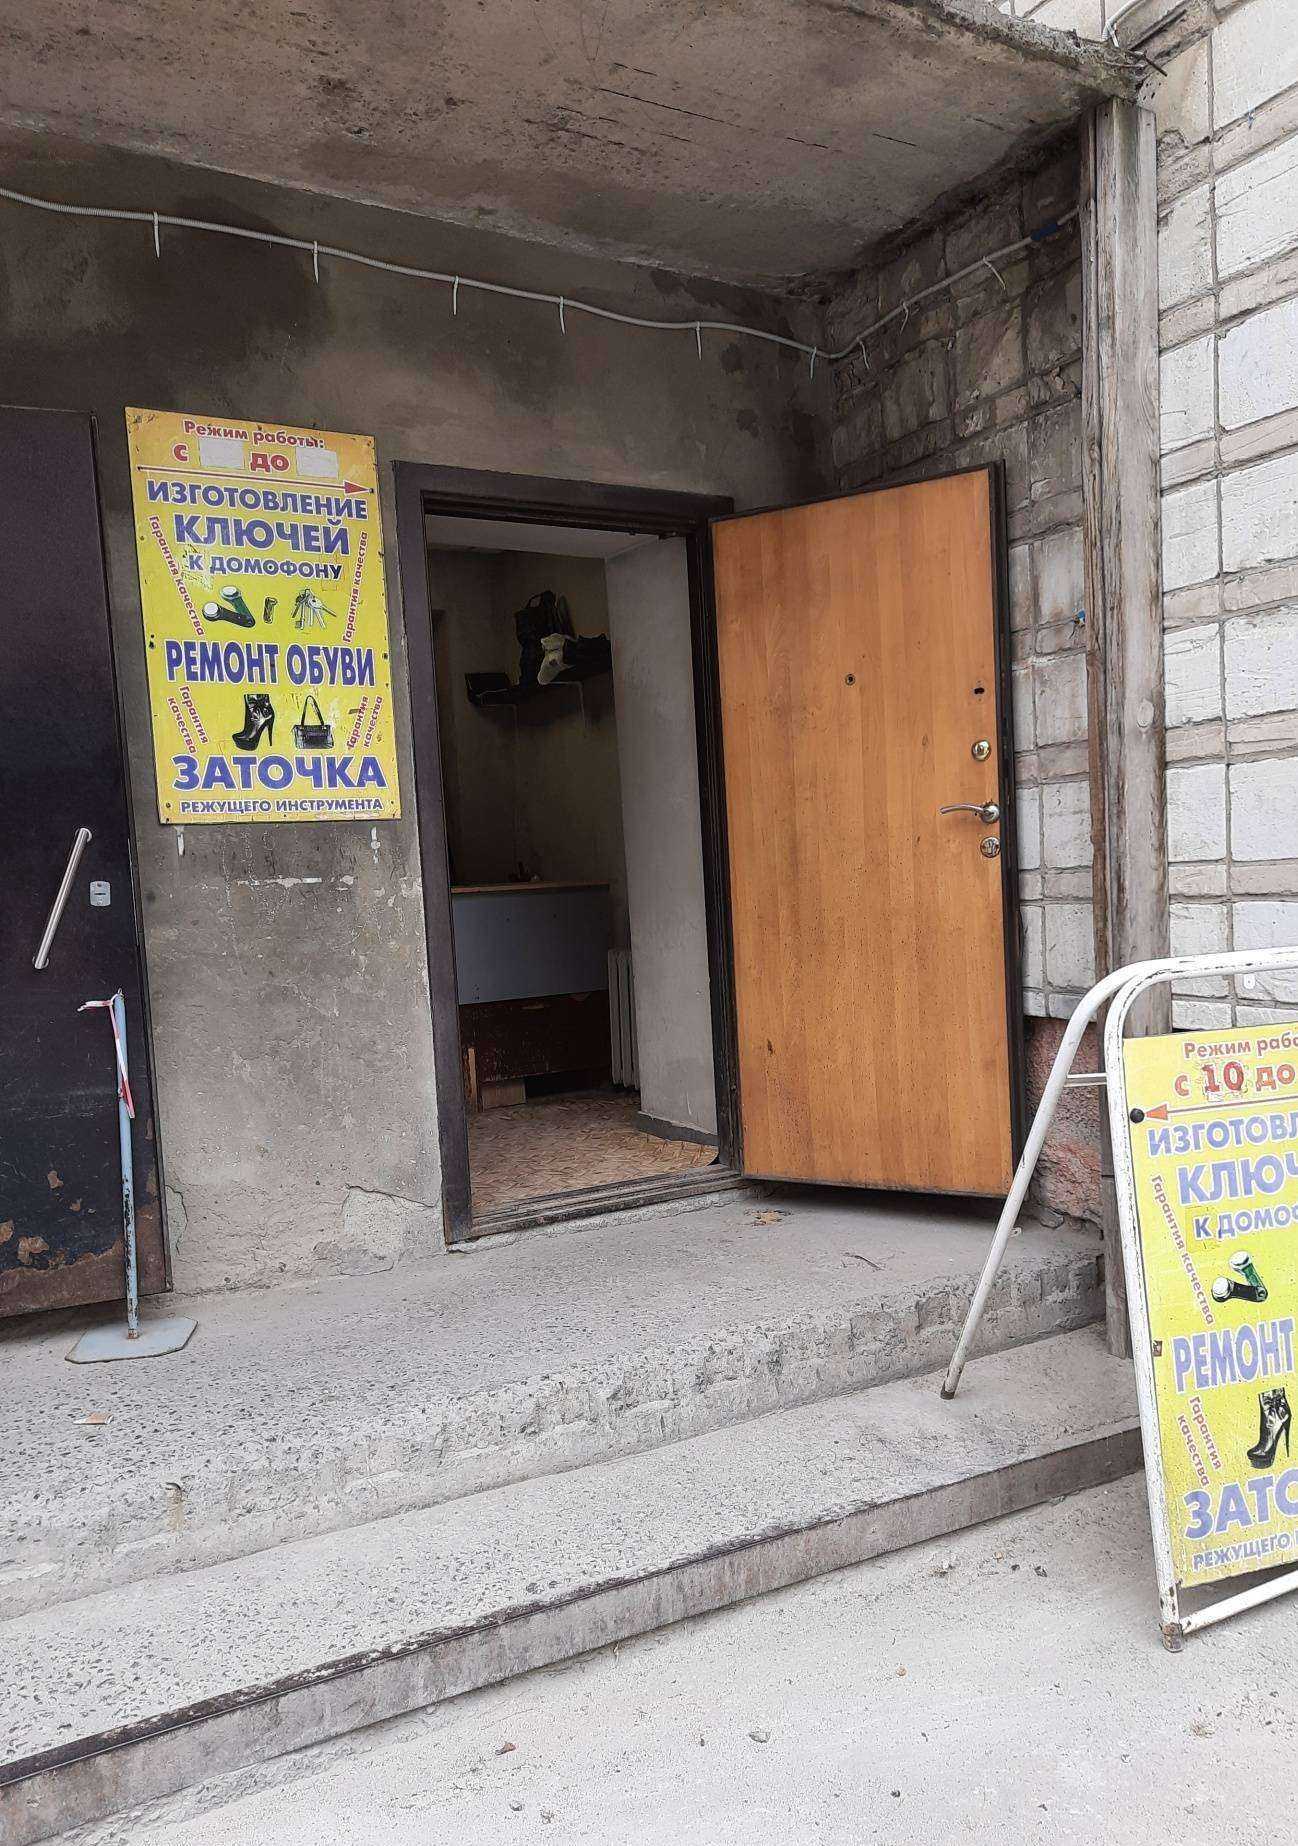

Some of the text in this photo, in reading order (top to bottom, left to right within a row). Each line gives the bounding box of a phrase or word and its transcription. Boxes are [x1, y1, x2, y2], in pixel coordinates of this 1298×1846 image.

[184, 420, 325, 448] Режим работы:
[147, 480, 368, 519] ИЗГОТОВЛЕНИЕ
[174, 514, 351, 555] КЛЮЧЕЙ
[210, 556, 343, 580] ДОМОФОНУ
[354, 531, 368, 586] качества
[176, 577, 205, 636] качества
[165, 640, 375, 687] РЕМОНТ ОБУВИ
[167, 697, 196, 754] качества
[363, 696, 383, 749] качества
[172, 754, 388, 791] ЗАТОЧКА
[181, 798, 383, 814] РЕЖУЩЕГО ИНСТРУМЕНТА
[1184, 1039, 1251, 1059] Режим
[1201, 1061, 1244, 1093] 10
[1181, 1252, 1215, 1325] качества
[1172, 1318, 1294, 1393] РЕМОНТ
[1178, 1414, 1210, 1487] качества
[1192, 1532, 1291, 1571] РЕЖУЩЕГО
